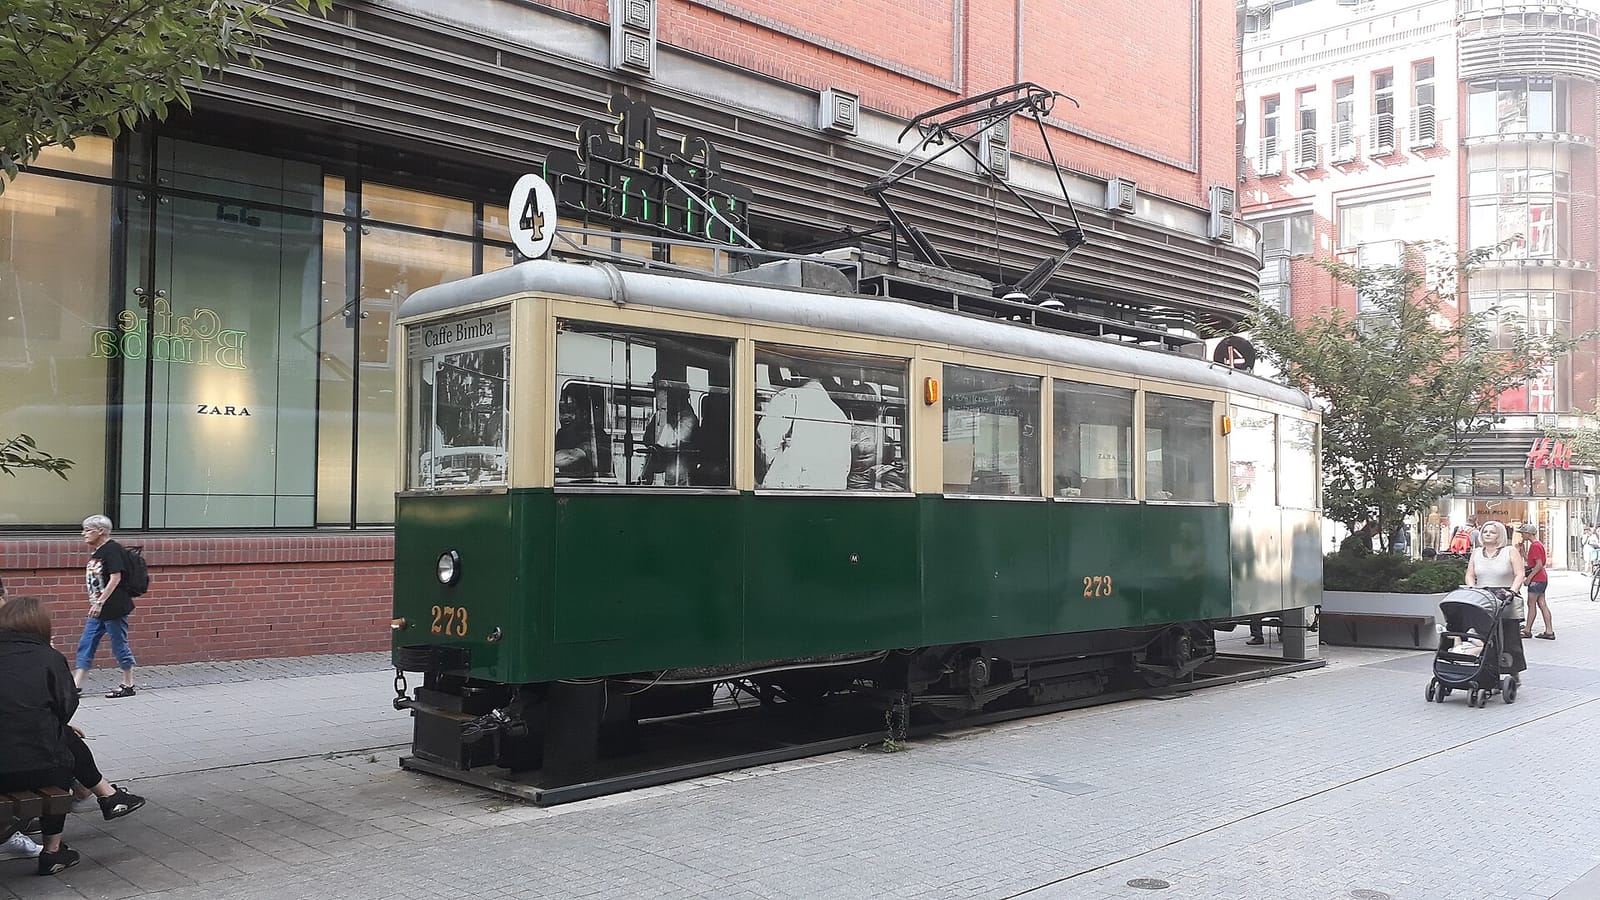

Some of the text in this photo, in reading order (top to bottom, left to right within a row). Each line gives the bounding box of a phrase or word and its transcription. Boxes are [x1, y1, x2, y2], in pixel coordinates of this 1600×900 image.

[519, 187, 545, 241] 4
[424, 318, 494, 348] Caffe Bimba
[197, 404, 251, 417] ZARA
[1083, 575, 1113, 598] 273
[431, 605, 468, 637] 273
